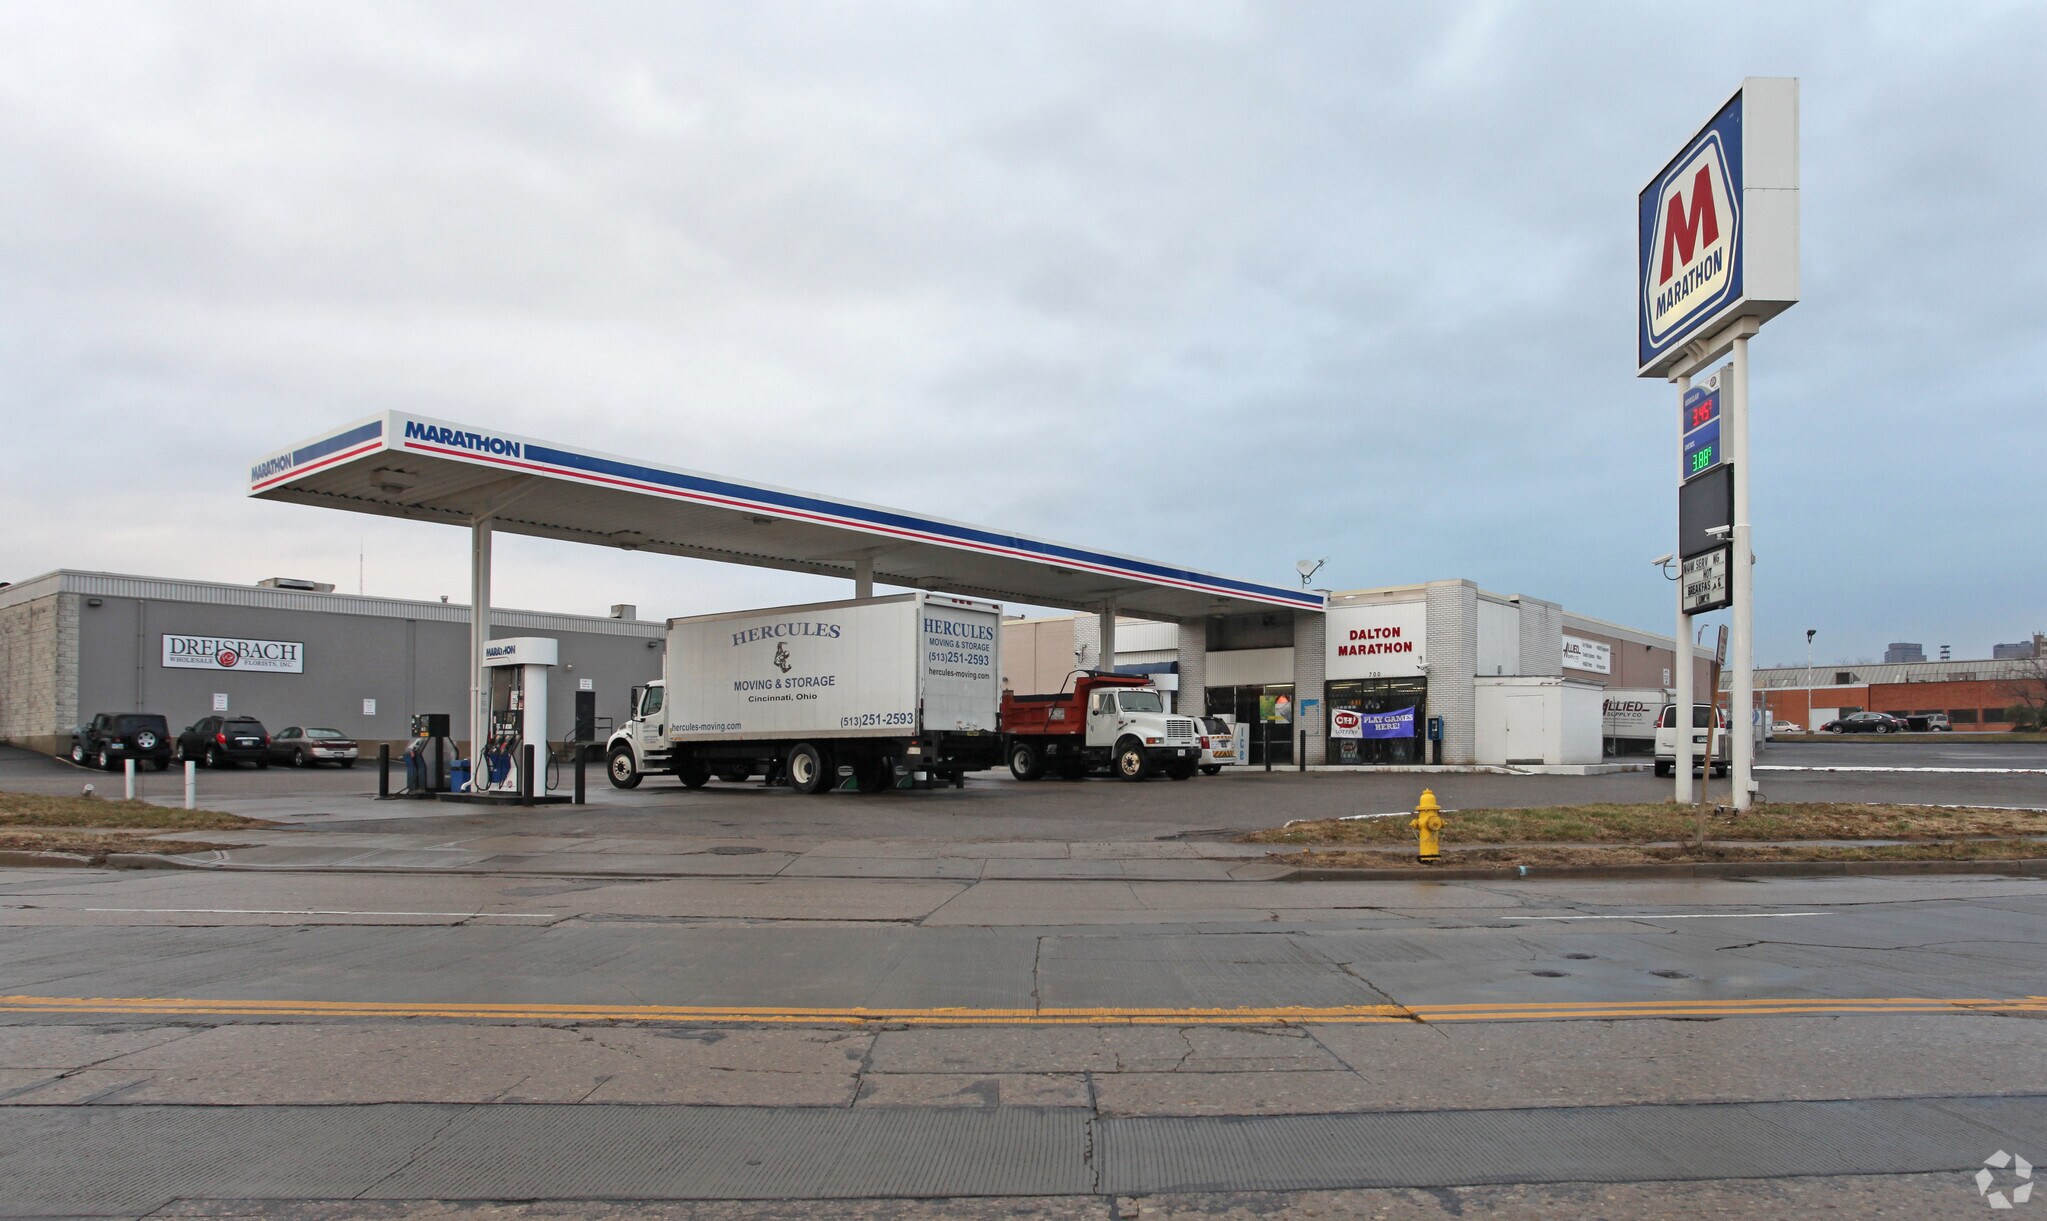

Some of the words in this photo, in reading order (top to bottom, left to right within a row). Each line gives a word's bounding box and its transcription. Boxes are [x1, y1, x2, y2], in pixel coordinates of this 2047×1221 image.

[1659, 163, 1719, 287] M
[1656, 246, 1723, 321] MARATHON
[404, 421, 521, 458] MARATHON
[251, 453, 292, 482] MARATHON
[732, 622, 841, 647] HERCULES
[924, 618, 993, 640] HERCULES
[1349, 627, 1401, 640] DALTON
[170, 638, 297, 660] DREISBACH
[929, 638, 954, 648] MOVING
[955, 641, 960, 649] &
[961, 641, 990, 652] STORAGE
[1338, 642, 1412, 656] MARATHON
[244, 660, 278, 668] FLORISTS,
[928, 651, 989, 666] (513)251-2593
[928, 667, 990, 680] hercules-moving.com
[734, 679, 772, 691] MOVING
[775, 679, 783, 689] &
[785, 676, 835, 688] STORAGE
[748, 695, 794, 703] Cincinnati,
[796, 693, 818, 701] Ohio
[840, 713, 914, 728] (513)251-2593
[1336, 716, 1356, 725] OH!
[1385, 714, 1413, 722] GAMES
[672, 722, 742, 733] hercules-moving.com
